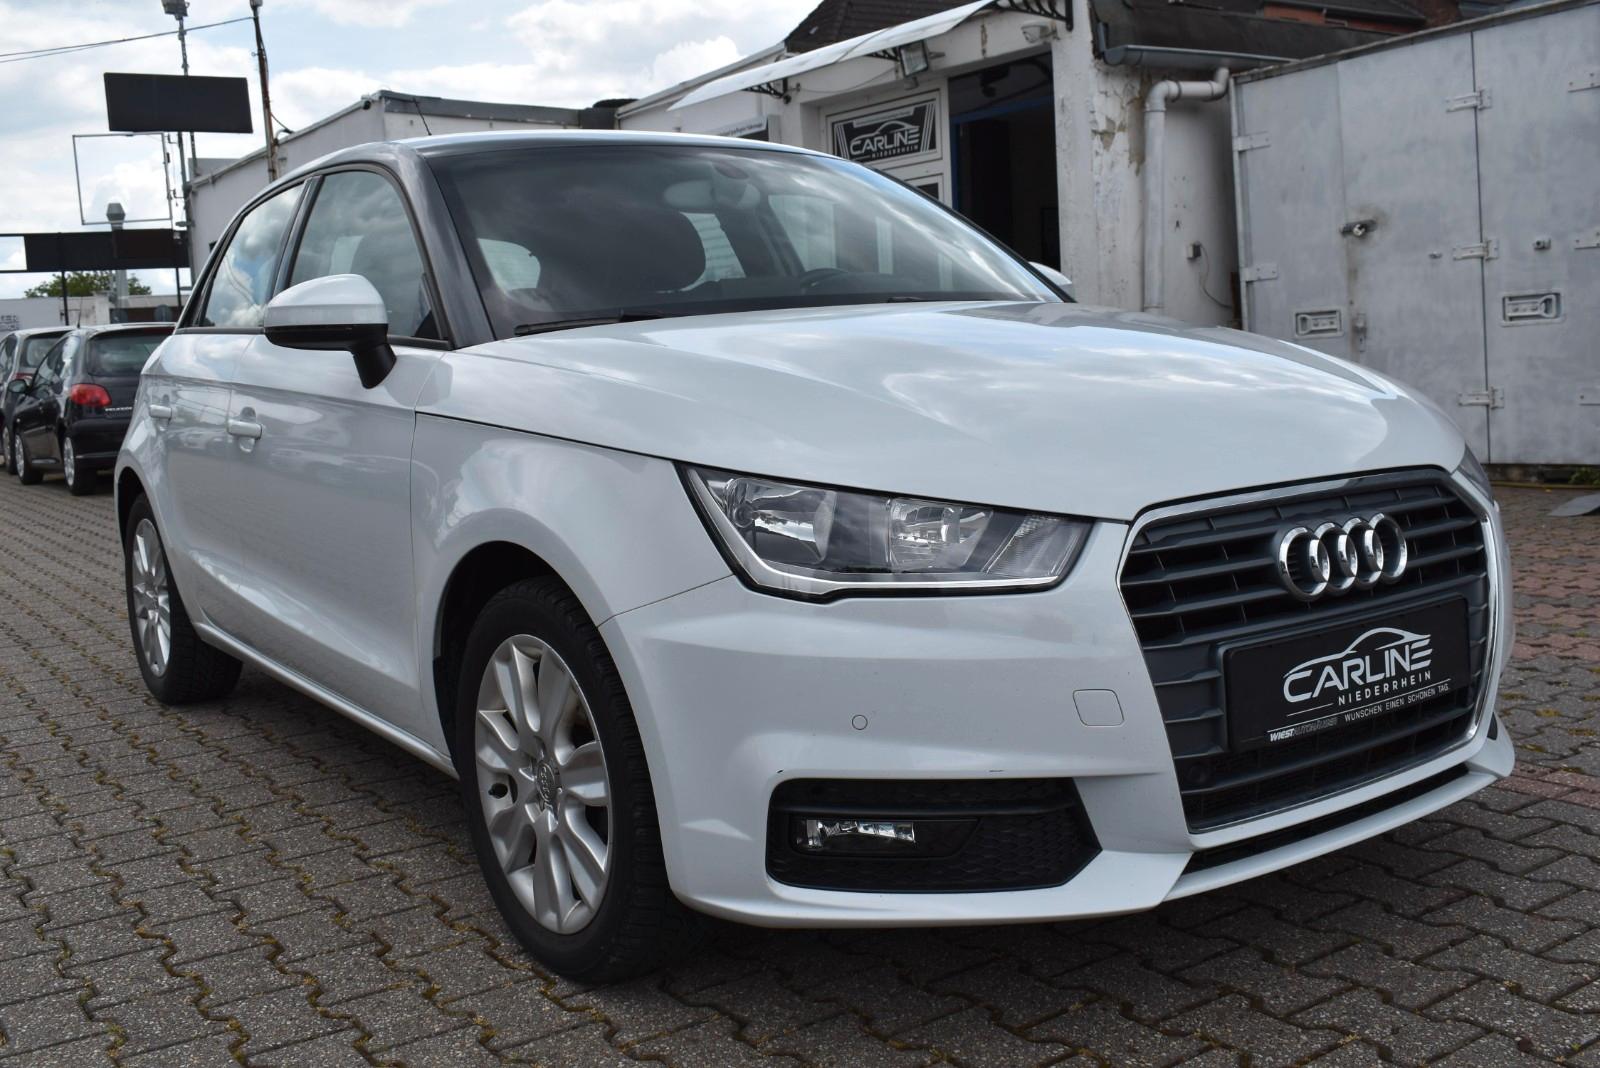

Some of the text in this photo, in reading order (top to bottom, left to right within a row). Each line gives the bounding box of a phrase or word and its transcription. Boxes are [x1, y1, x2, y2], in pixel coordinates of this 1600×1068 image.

[850, 127, 919, 156] CARLINE
[1284, 638, 1432, 703] CARLINE
[1338, 670, 1431, 706] NIEDERRHEIN
[1385, 697, 1405, 710] EINEN
